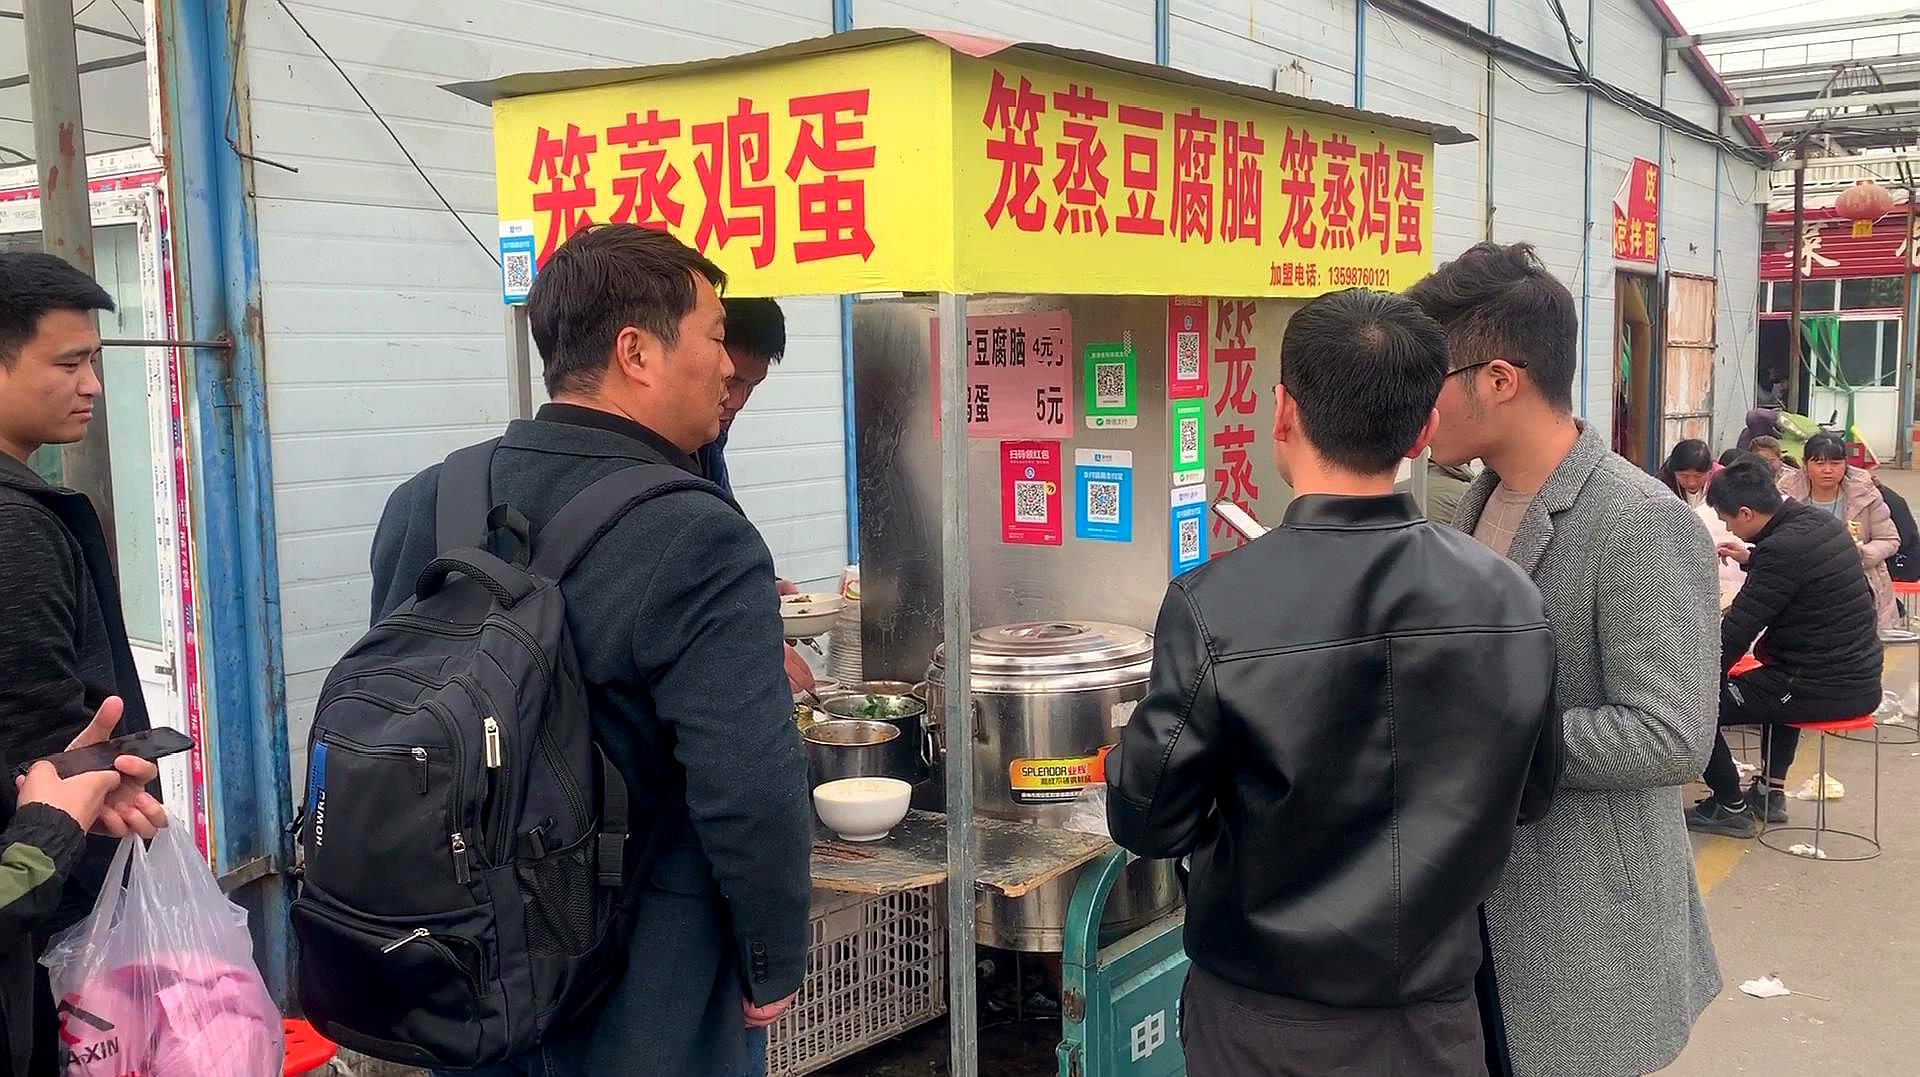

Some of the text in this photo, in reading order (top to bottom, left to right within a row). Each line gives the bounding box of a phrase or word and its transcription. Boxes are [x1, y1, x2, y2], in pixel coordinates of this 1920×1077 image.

[528, 88, 877, 272] 笼蒸鸡蛋
[982, 68, 1425, 256] 笼蒸豆腐脑 笼蒸鸡蛋
[1032, 336, 1054, 357] 4元
[1036, 386, 1064, 425] 5元
[1021, 766, 1067, 777] SPLENDOR
